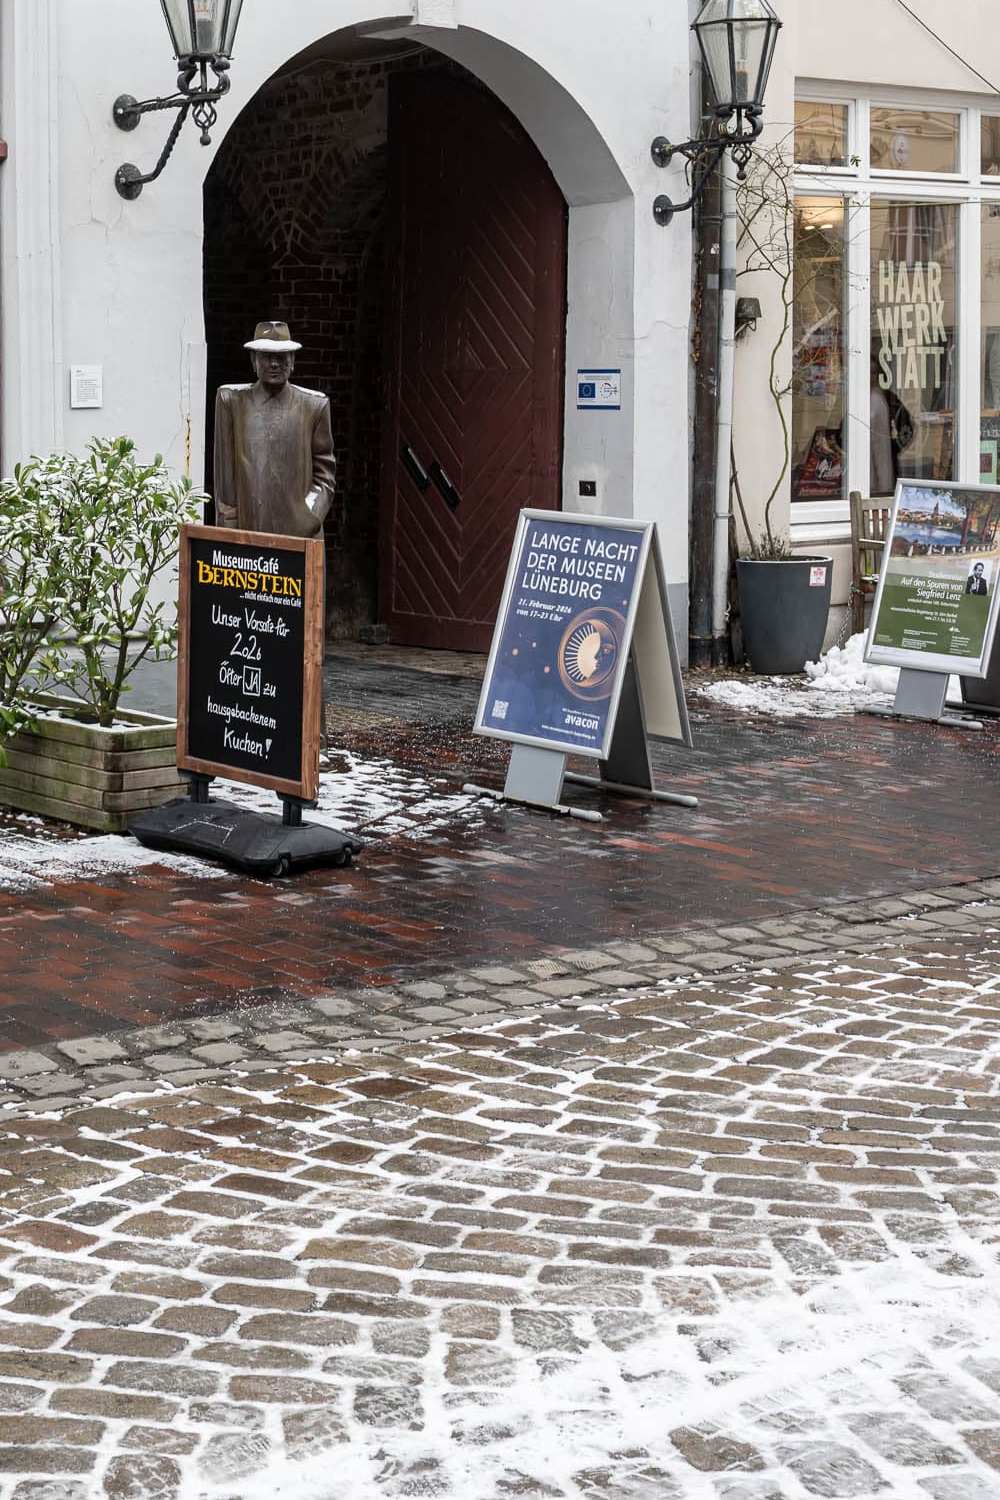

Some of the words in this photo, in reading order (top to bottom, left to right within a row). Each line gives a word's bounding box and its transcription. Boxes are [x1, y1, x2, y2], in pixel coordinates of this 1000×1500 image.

[878, 260, 942, 304] HAAR
[876, 300, 948, 354] WERK
[878, 346, 945, 390] STATT
[213, 549, 280, 575] MuseumsCafé
[531, 531, 582, 555] LANGE
[584, 539, 639, 562] NACHT
[196, 559, 302, 597] BERNSTEIN
[527, 551, 557, 572] DER
[560, 556, 626, 583] MUSEEN
[521, 569, 603, 601] LÜNEBURG
[211, 604, 242, 629] Unser
[244, 606, 275, 633] Vorsatz
[244, 670, 259, 693] JA
[262, 683, 277, 698] zu
[564, 713, 599, 730] avacon
